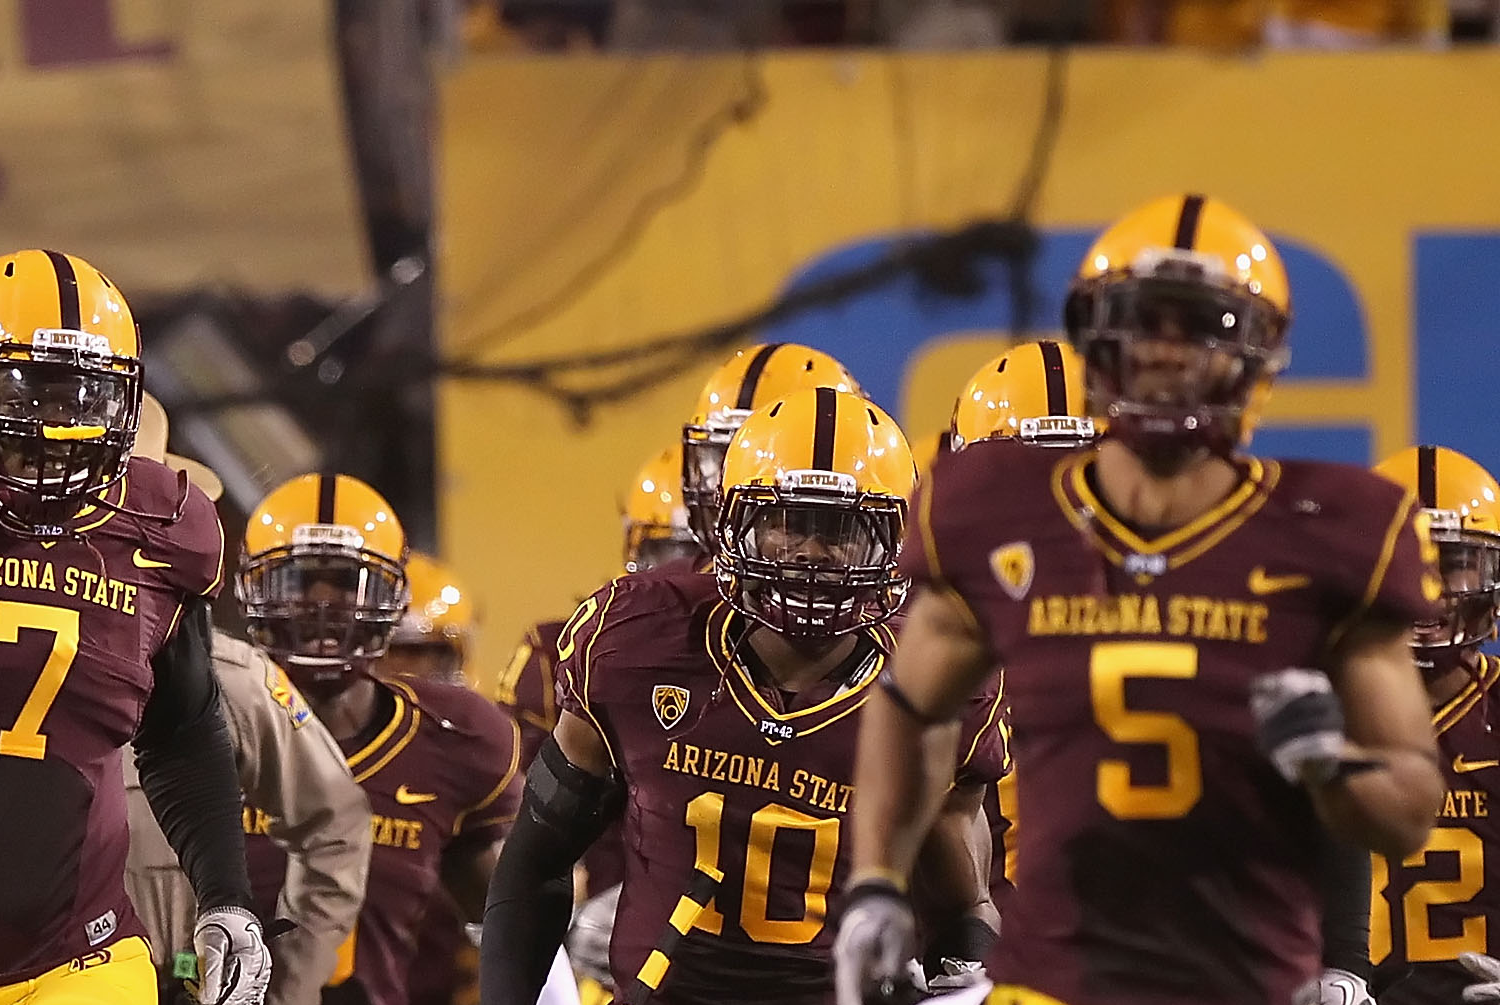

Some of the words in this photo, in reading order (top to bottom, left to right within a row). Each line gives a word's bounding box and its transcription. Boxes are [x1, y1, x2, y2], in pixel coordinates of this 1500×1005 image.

[63, 565, 137, 615] STATE
[1028, 595, 1162, 637] ARIZONA
[1167, 596, 1270, 643] STATE
[1090, 641, 1201, 818] 5
[663, 742, 781, 792] ARIZONA
[789, 770, 857, 814] STAT
[1435, 790, 1488, 818] ATE
[371, 814, 423, 849] TATE
[685, 791, 840, 944] 10
[93, 918, 111, 934] 44
